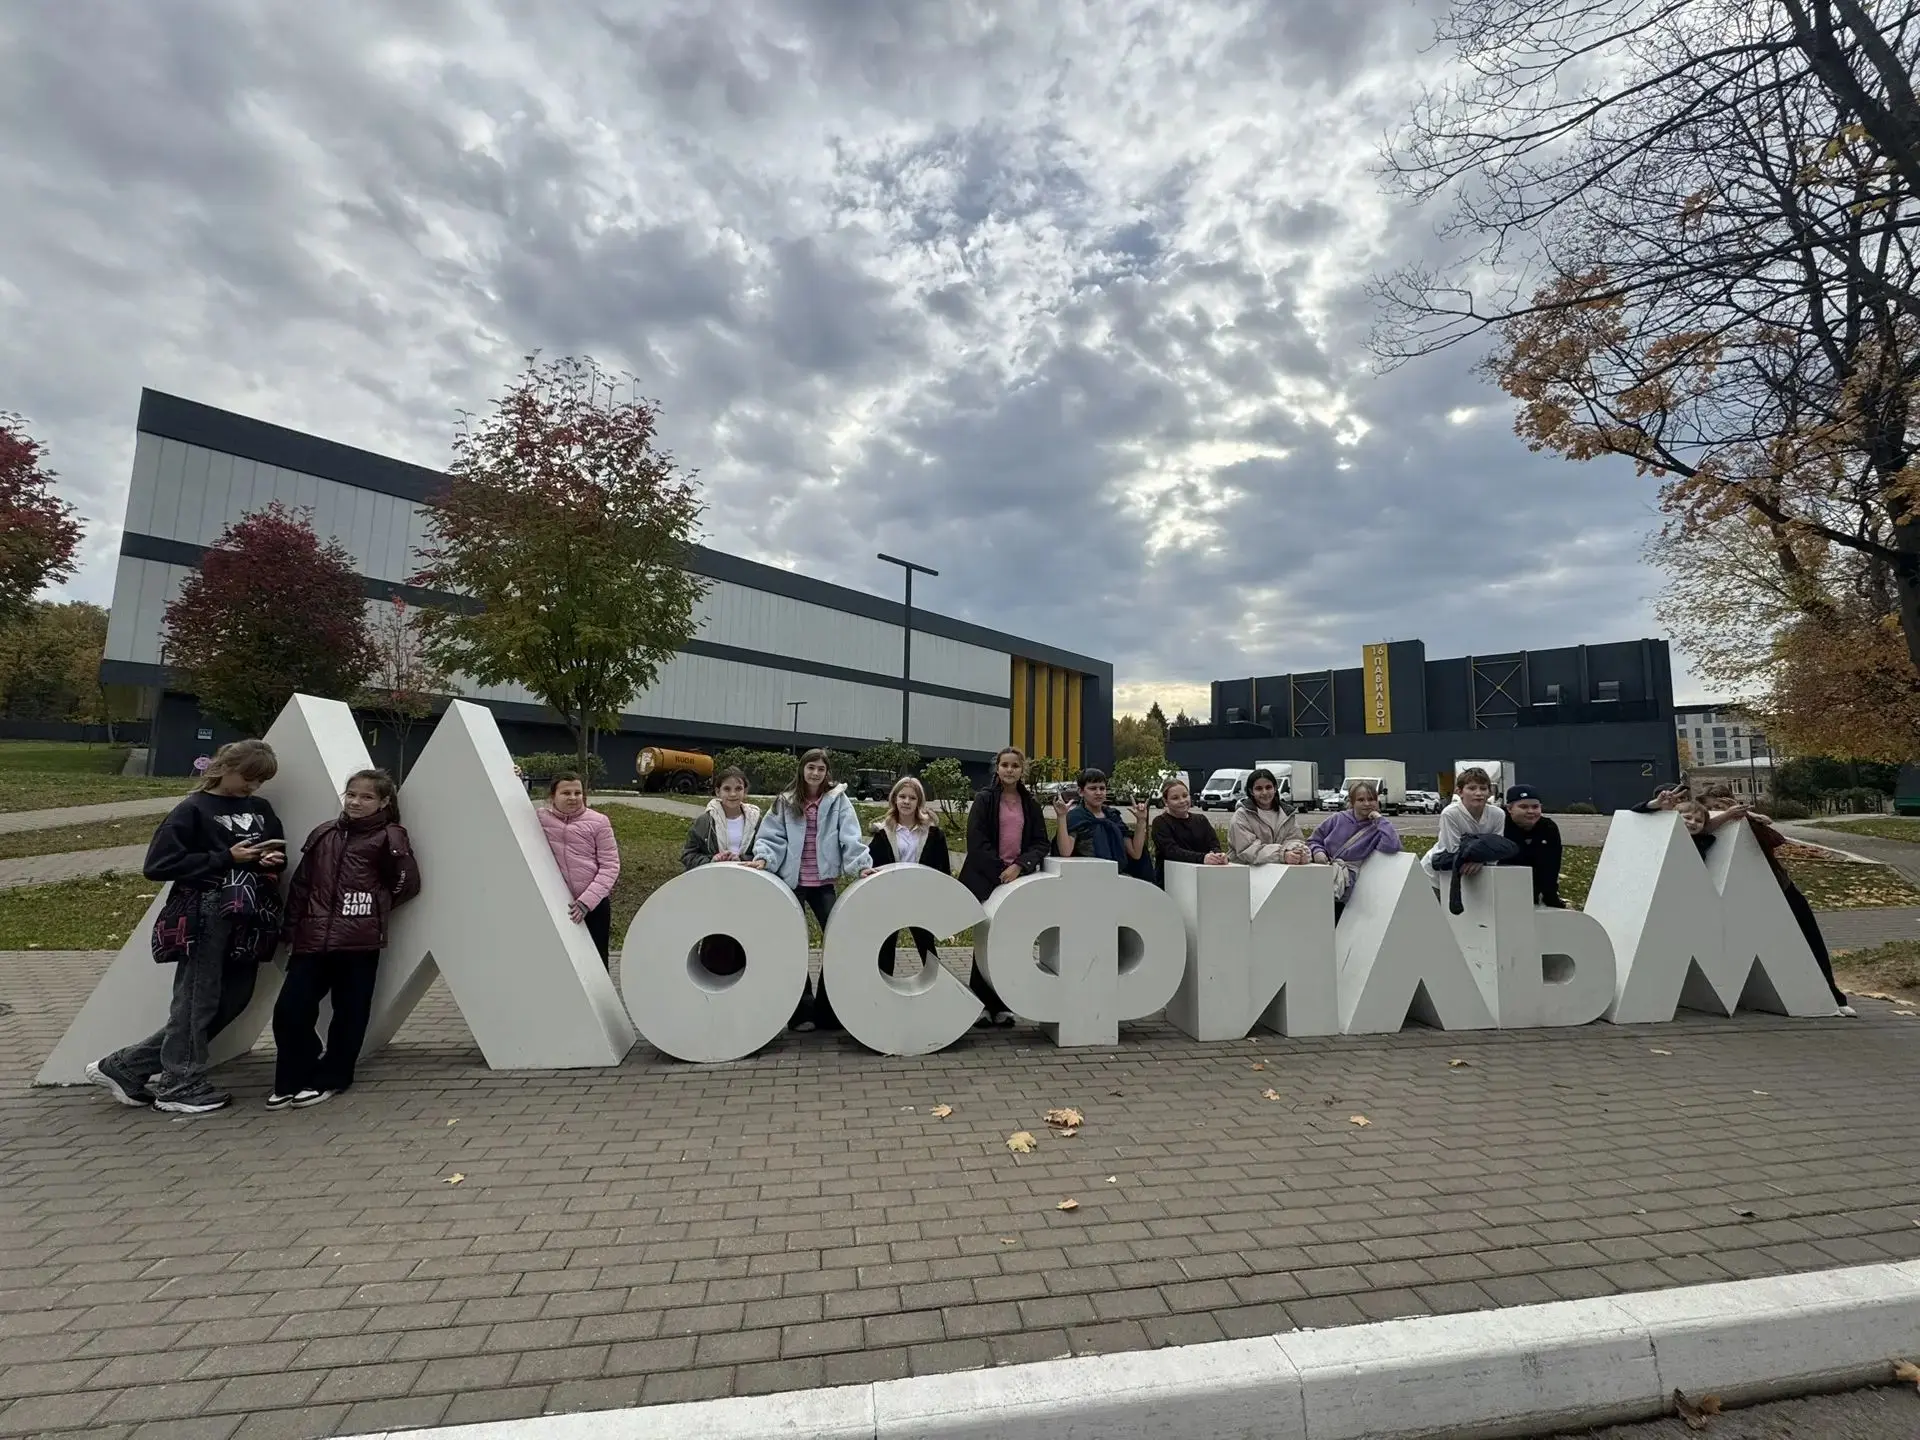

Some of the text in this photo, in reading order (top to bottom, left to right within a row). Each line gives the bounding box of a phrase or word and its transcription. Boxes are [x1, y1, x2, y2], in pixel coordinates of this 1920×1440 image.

[1371, 645, 1385, 656] 16
[1374, 656, 1386, 727] ПАВИЛЬОН
[368, 727, 378, 747] 1
[1641, 762, 1653, 776] 2
